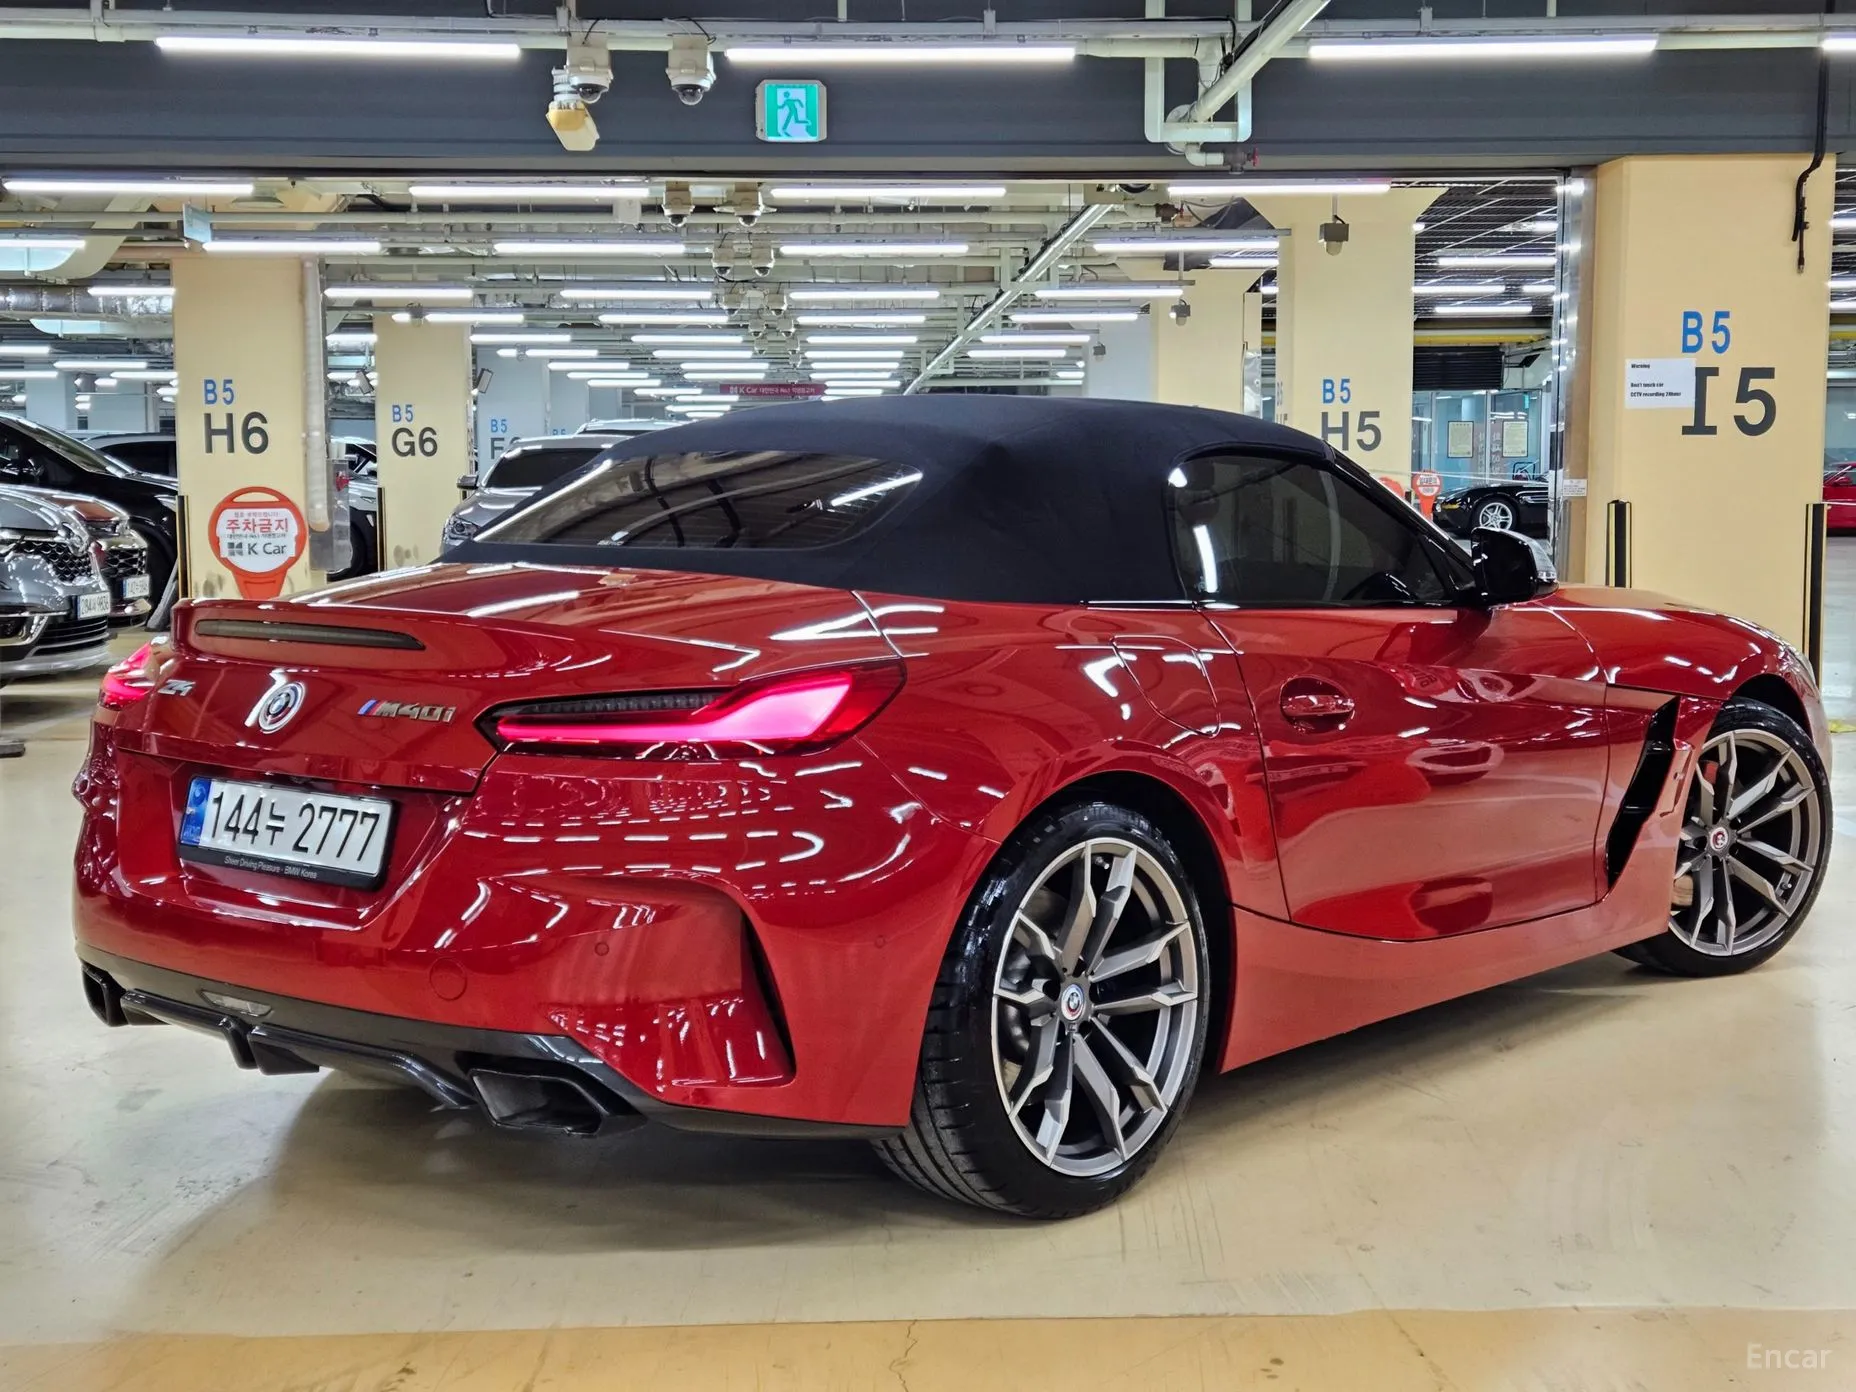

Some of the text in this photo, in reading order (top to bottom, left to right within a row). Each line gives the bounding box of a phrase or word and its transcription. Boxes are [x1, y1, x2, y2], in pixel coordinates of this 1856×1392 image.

[1682, 311, 1730, 354] B5
[203, 379, 235, 405] B5
[1322, 379, 1351, 404] B5
[1682, 367, 1776, 436] I5
[392, 404, 414, 422] B5
[203, 411, 269, 455] H6
[490, 419, 508, 433] B5
[1321, 411, 1382, 451] H5
[391, 427, 438, 457] G6
[490, 437, 520, 459] F
[226, 518, 289, 533] 주차금지
[247, 543, 287, 555] K Car
[158, 679, 196, 696] Z4
[375, 700, 457, 722] M40i
[212, 791, 381, 862] 144누 2777
[240, 858, 257, 871] Driving
[258, 862, 280, 873] Pleasure
[284, 866, 299, 876] BMW
[301, 868, 317, 879] Korea
